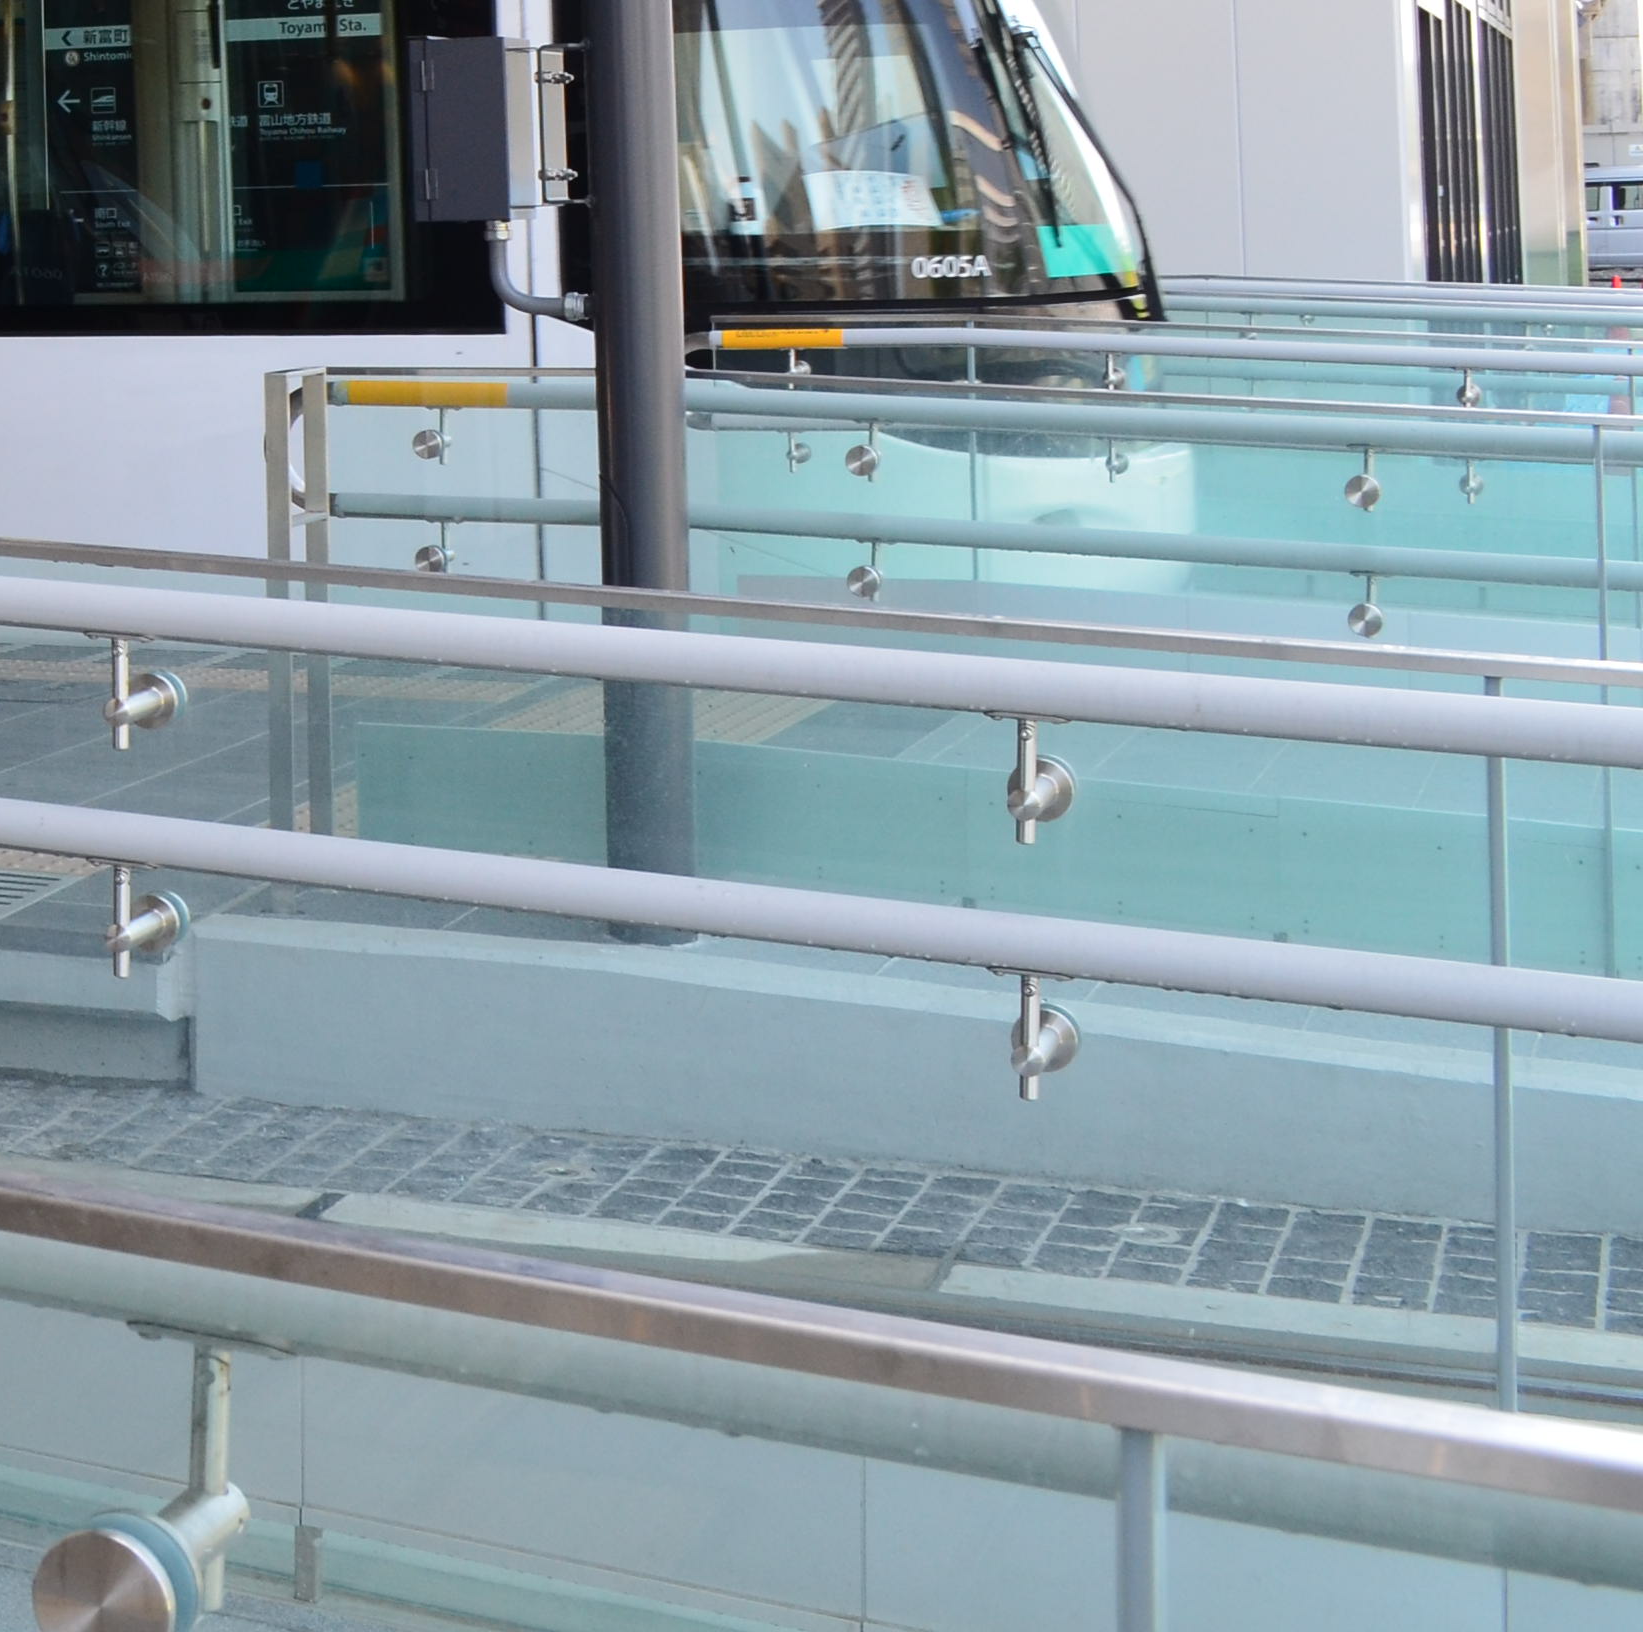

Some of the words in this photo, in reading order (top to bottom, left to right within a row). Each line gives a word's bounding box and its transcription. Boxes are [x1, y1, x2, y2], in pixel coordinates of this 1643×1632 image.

[279, 21, 328, 38] Toyam
[339, 18, 367, 32] Sta.
[911, 254, 993, 279] 0605A
